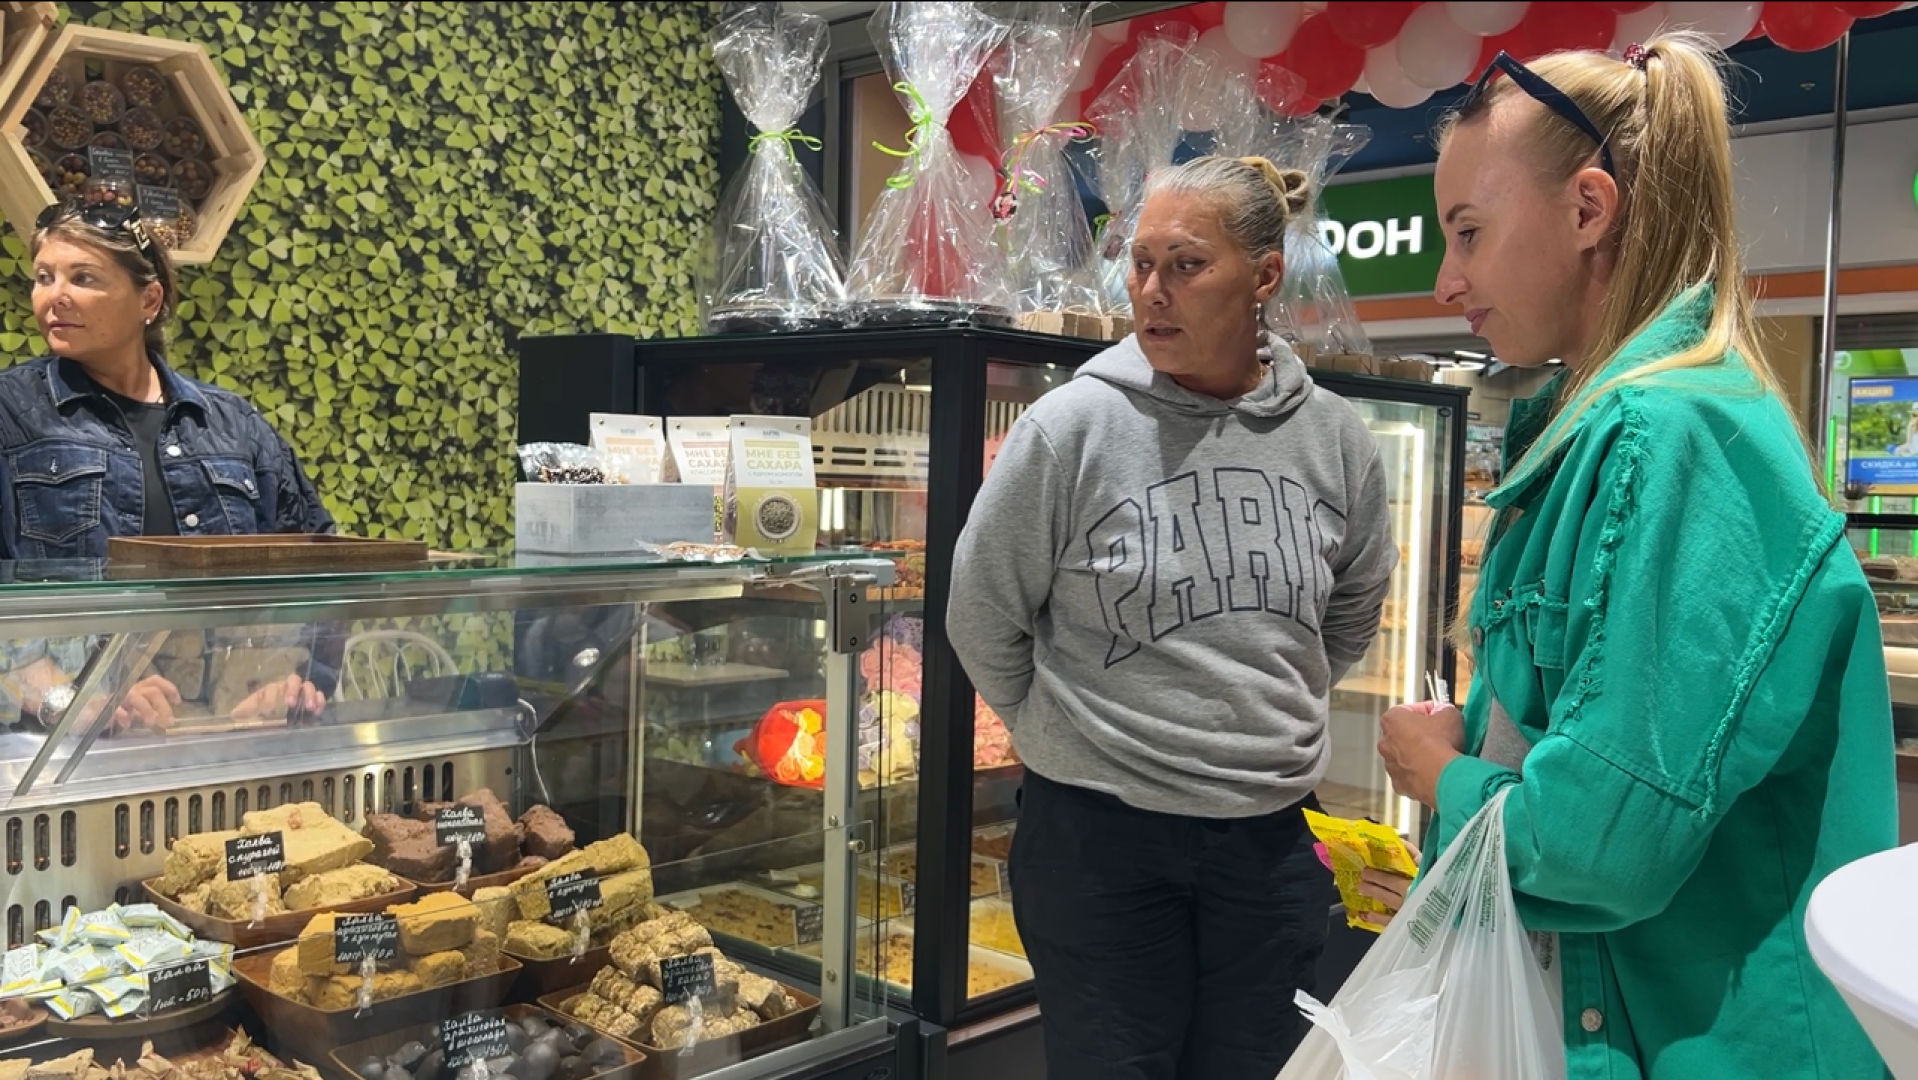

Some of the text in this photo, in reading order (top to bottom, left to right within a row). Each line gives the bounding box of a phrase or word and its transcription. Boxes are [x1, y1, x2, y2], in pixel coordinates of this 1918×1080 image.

[713, 449, 728, 458] БЕ
[745, 448, 801, 460] МНЕ БЕЗ
[745, 459, 803, 470] САХАРА
[1860, 461, 1902, 470] СКИДКА
